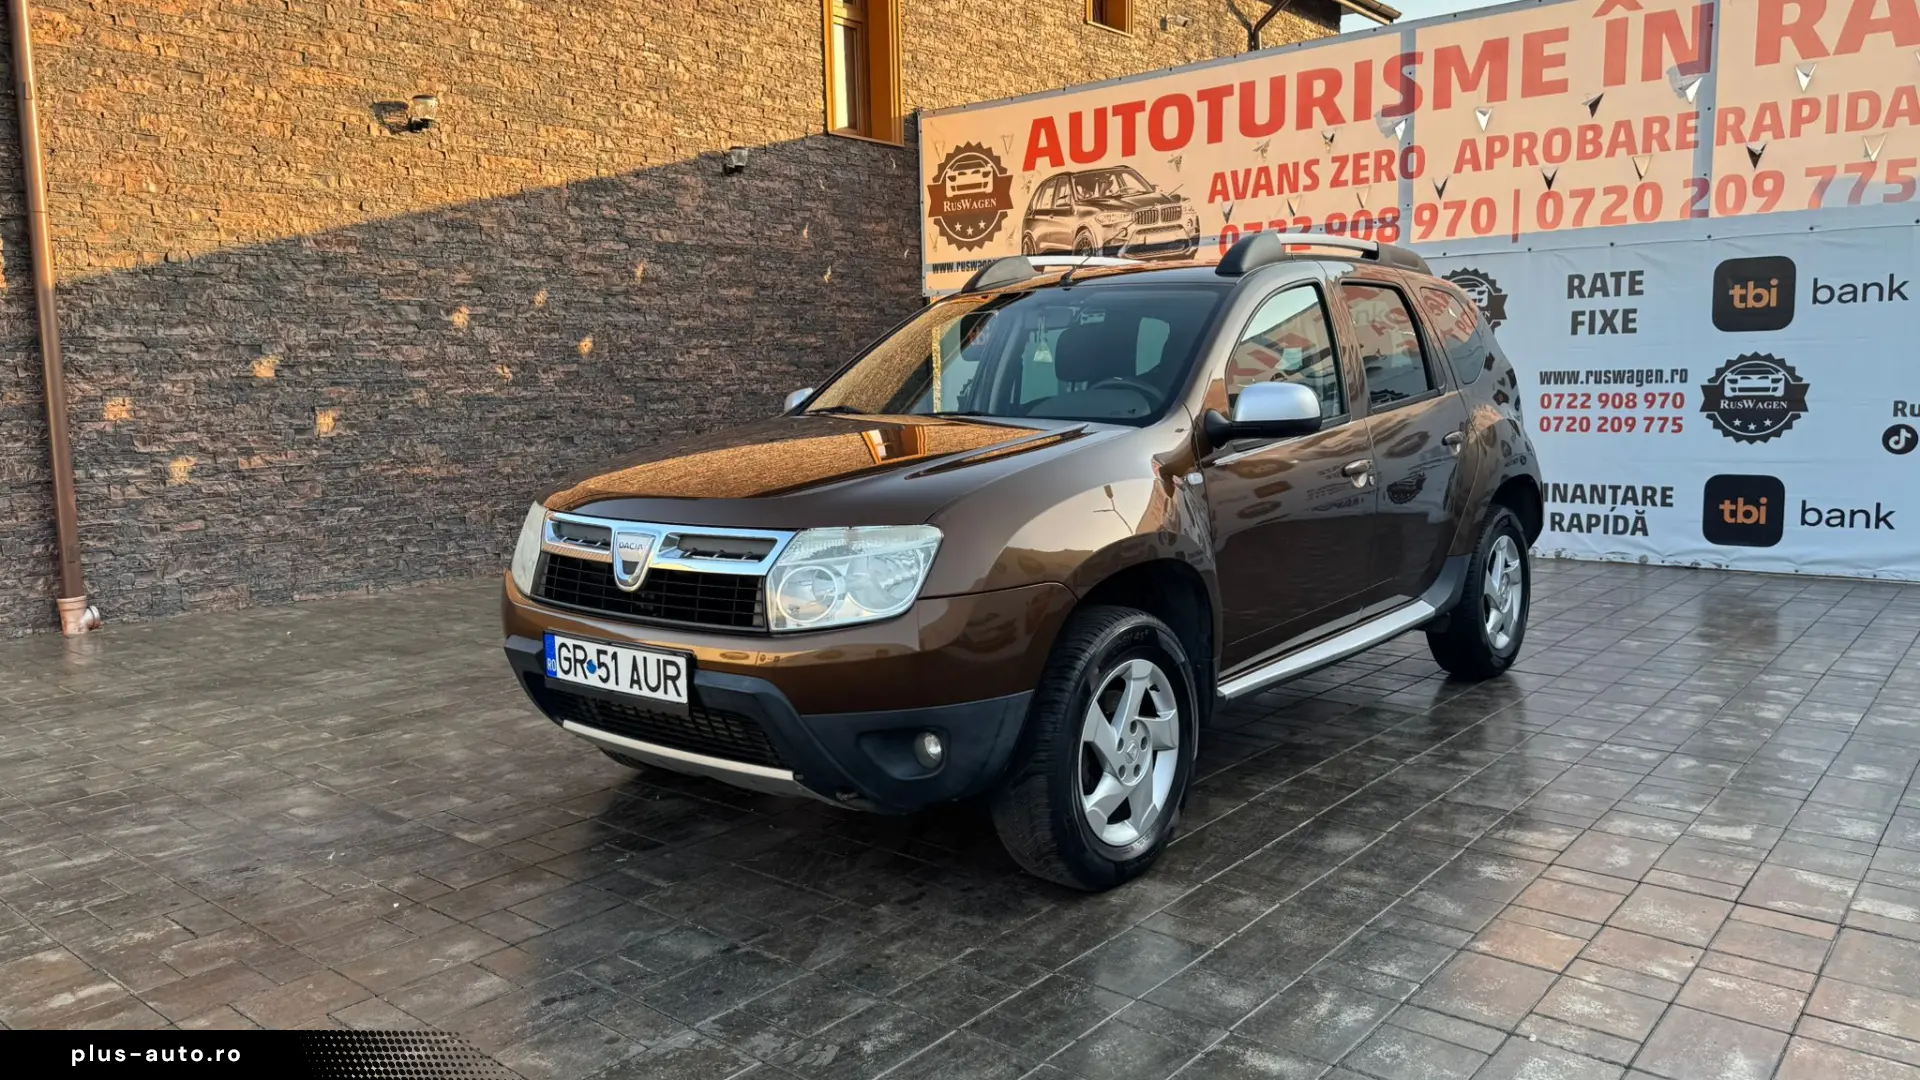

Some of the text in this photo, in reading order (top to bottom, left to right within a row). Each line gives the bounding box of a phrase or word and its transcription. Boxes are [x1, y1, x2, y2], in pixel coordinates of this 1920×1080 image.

[1022, 26, 1569, 172] AUTOTURISME
[1592, 0, 1714, 87] ÎN
[1208, 84, 1920, 204] AVANS ZERO APROBARE RAPIDA
[1324, 207, 1401, 243] 908
[1414, 196, 1498, 240] 970
[1536, 181, 1663, 229] 0720
[1679, 170, 1785, 219] 209
[1805, 157, 1918, 210] 775
[1567, 270, 1644, 299] RATE
[1728, 273, 1910, 309] tbi bank
[1570, 308, 1638, 336] FIXE
[1539, 368, 1689, 387] www.ruswagen.ro
[1540, 391, 1686, 409] 0722 908 970
[1539, 416, 1684, 433] 0720 209 775
[1719, 497, 1896, 530] tbi bank
[618, 541, 644, 550] DACIA
[557, 642, 682, 698] GR 51 AUR
